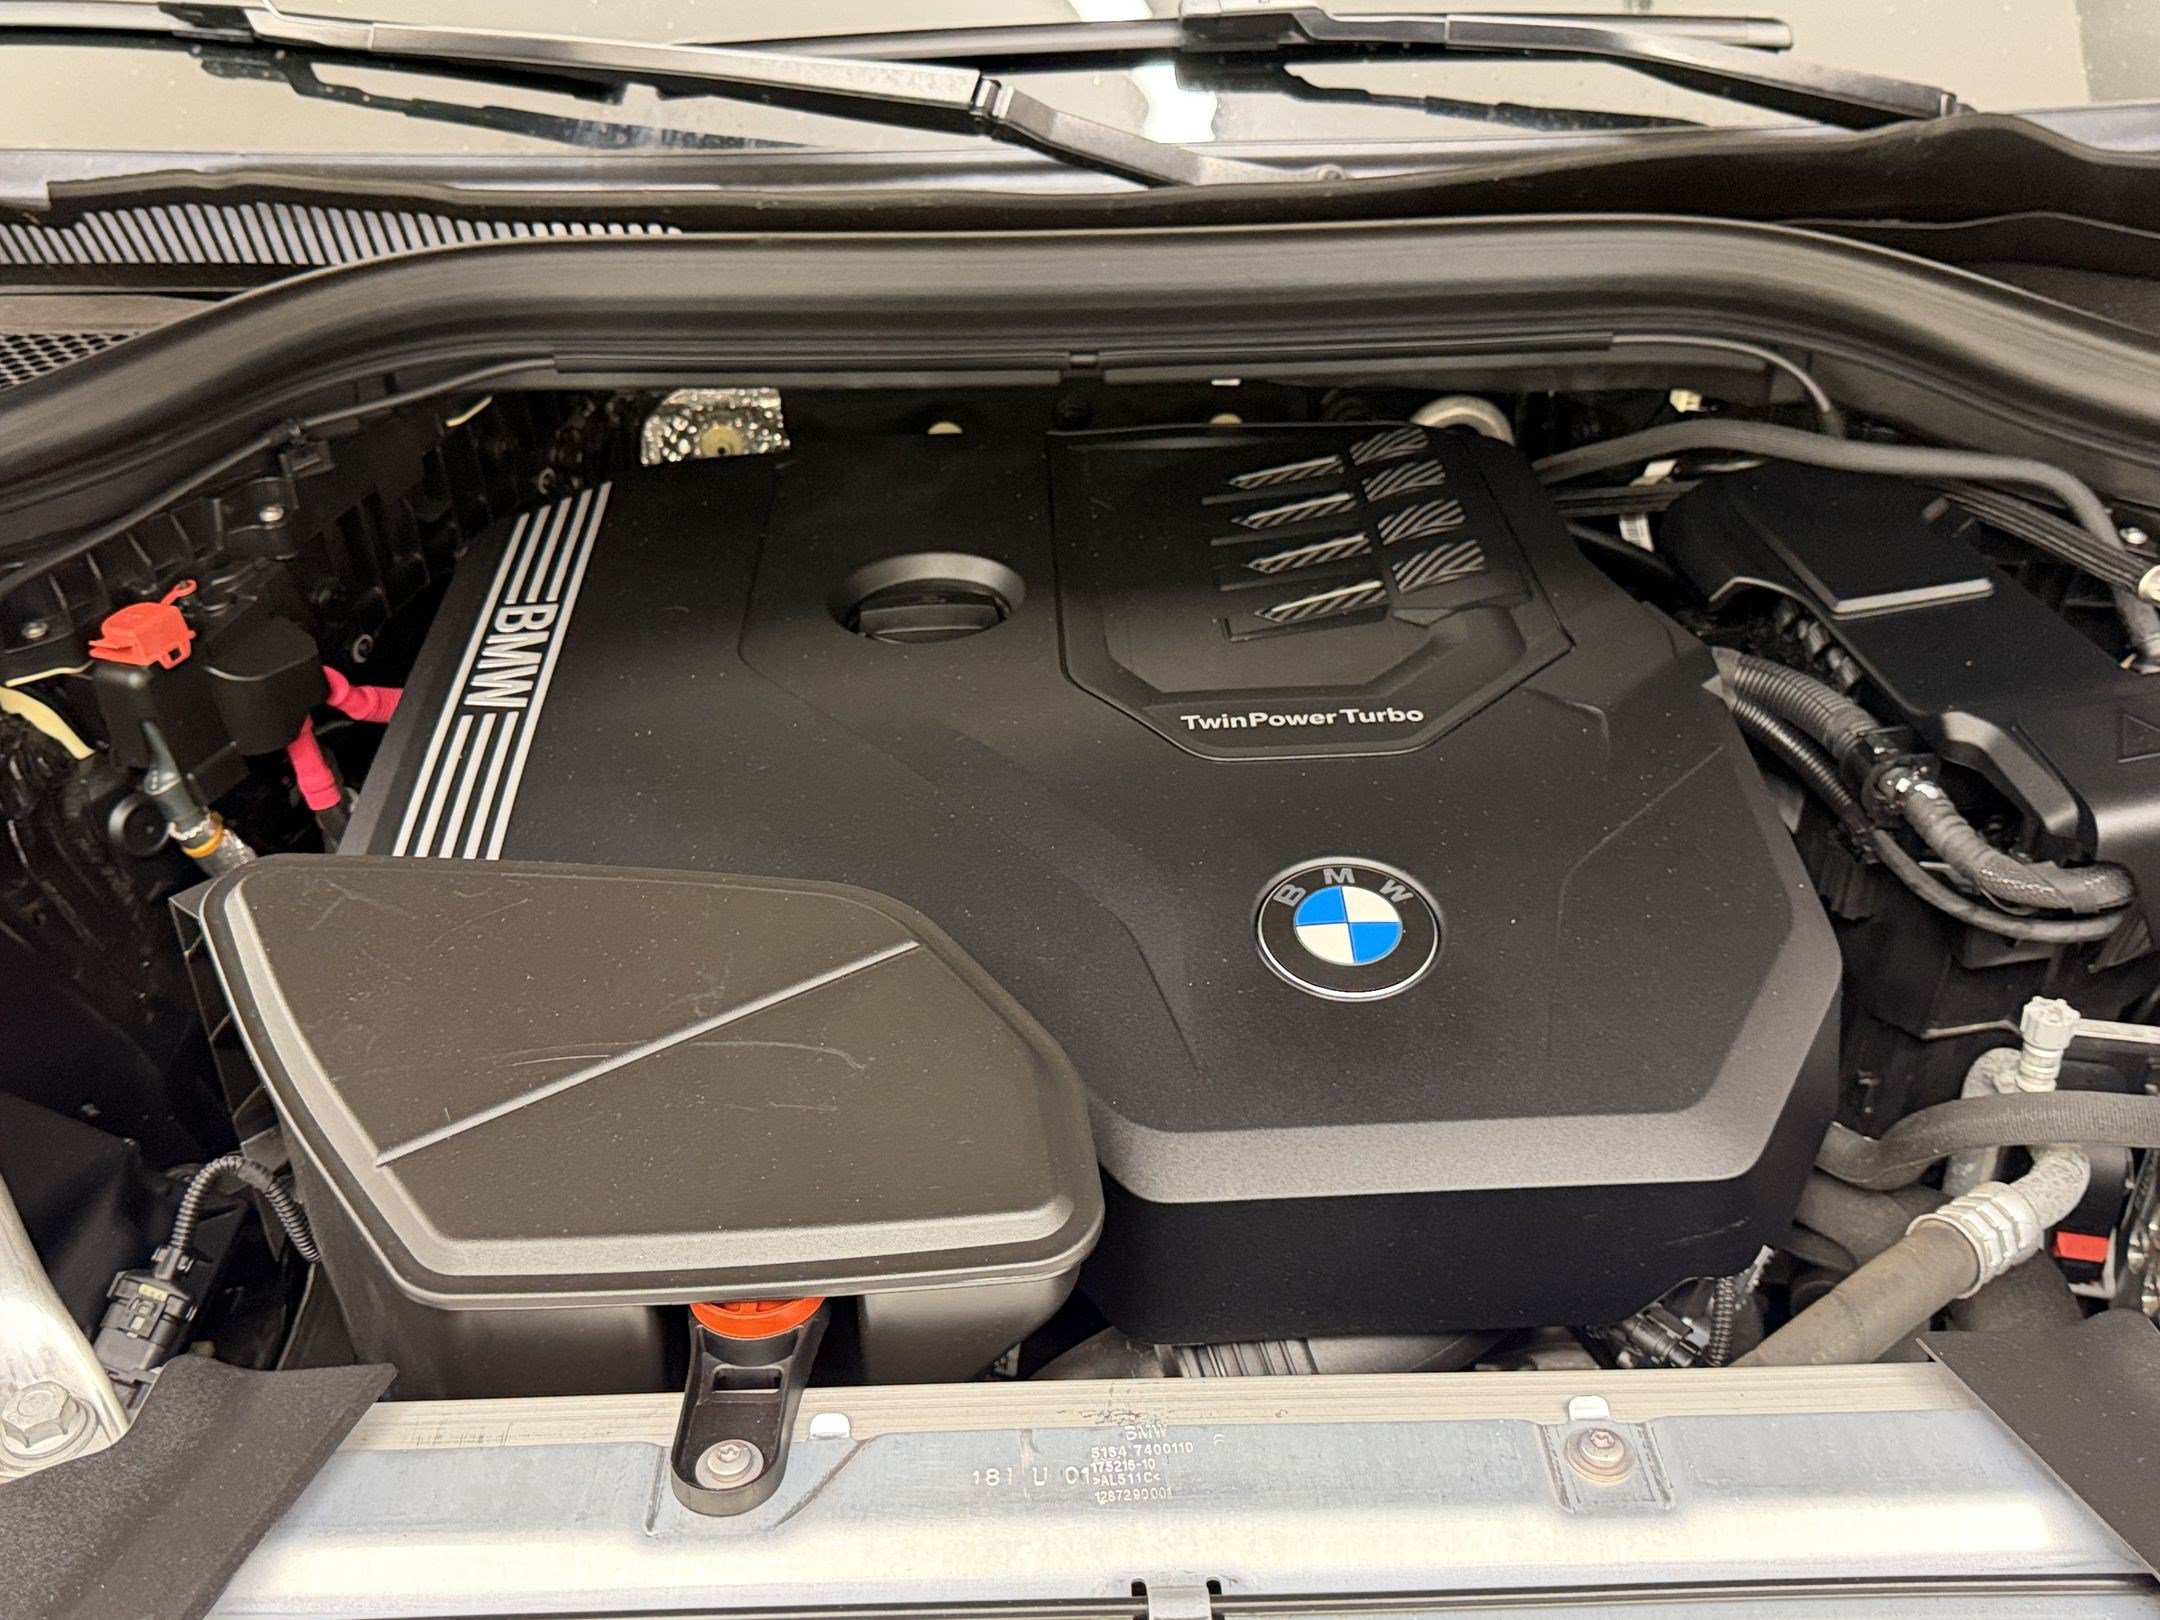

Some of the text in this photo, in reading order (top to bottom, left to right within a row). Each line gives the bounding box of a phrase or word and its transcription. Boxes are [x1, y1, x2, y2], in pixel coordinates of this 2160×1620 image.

[463, 603, 559, 708] BMW
[1180, 707, 1424, 731] TwinPower Turbo
[1273, 867, 1414, 908] BMW
[1124, 1423, 1168, 1441] BMW
[1133, 1441, 1194, 1457] 7400110
